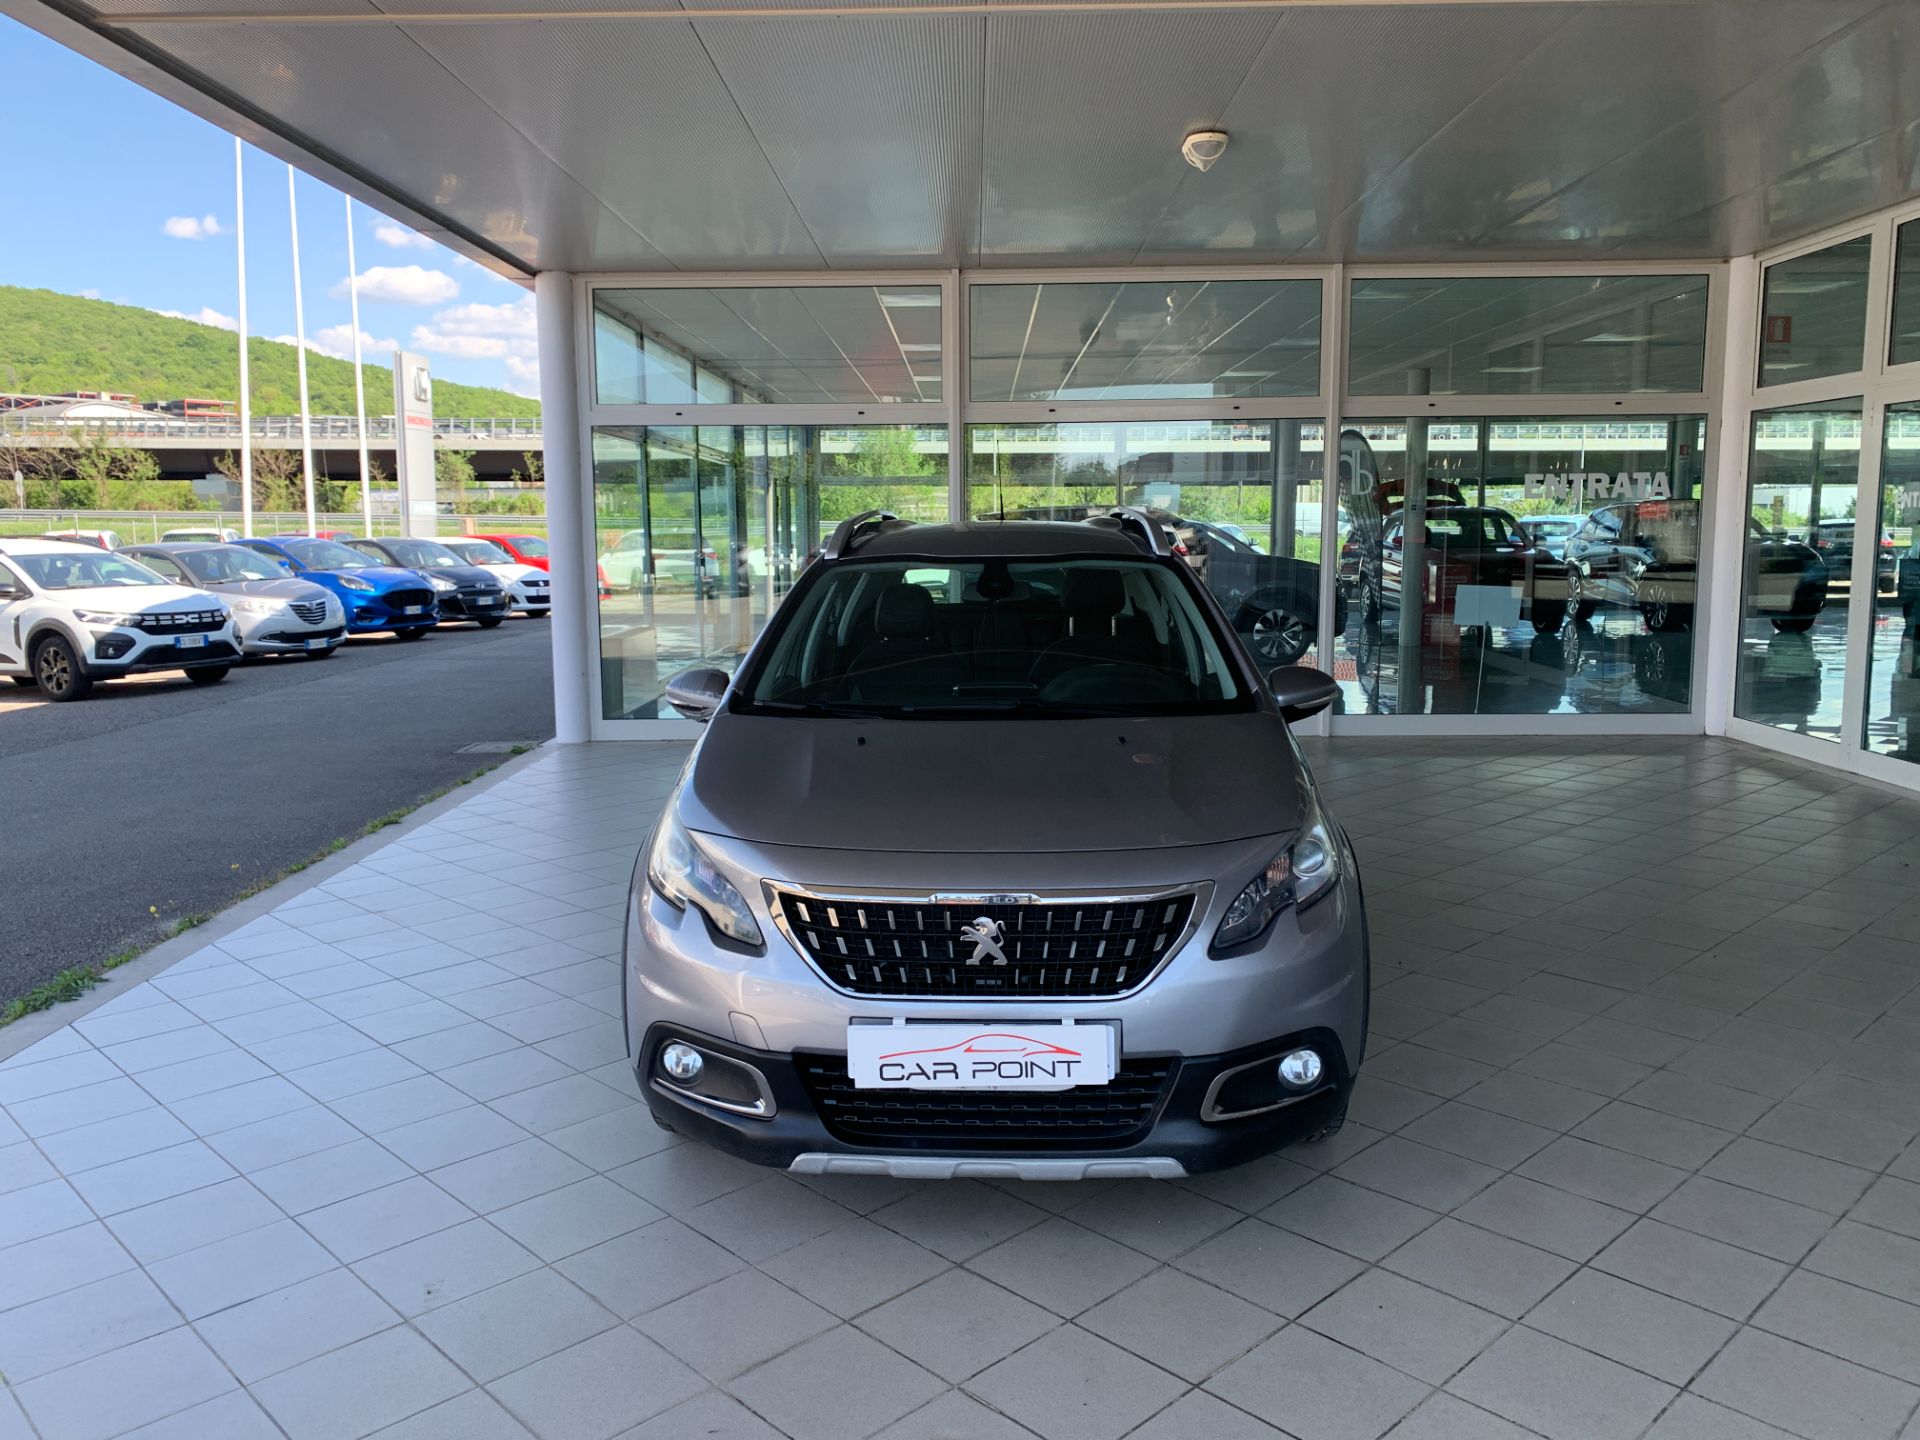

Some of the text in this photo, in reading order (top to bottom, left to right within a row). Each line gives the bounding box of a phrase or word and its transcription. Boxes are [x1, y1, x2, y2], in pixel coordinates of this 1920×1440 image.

[1524, 471, 1672, 499] ENTRATA
[1895, 491, 1920, 508] ENT
[879, 1060, 1082, 1082] CAR POINT
